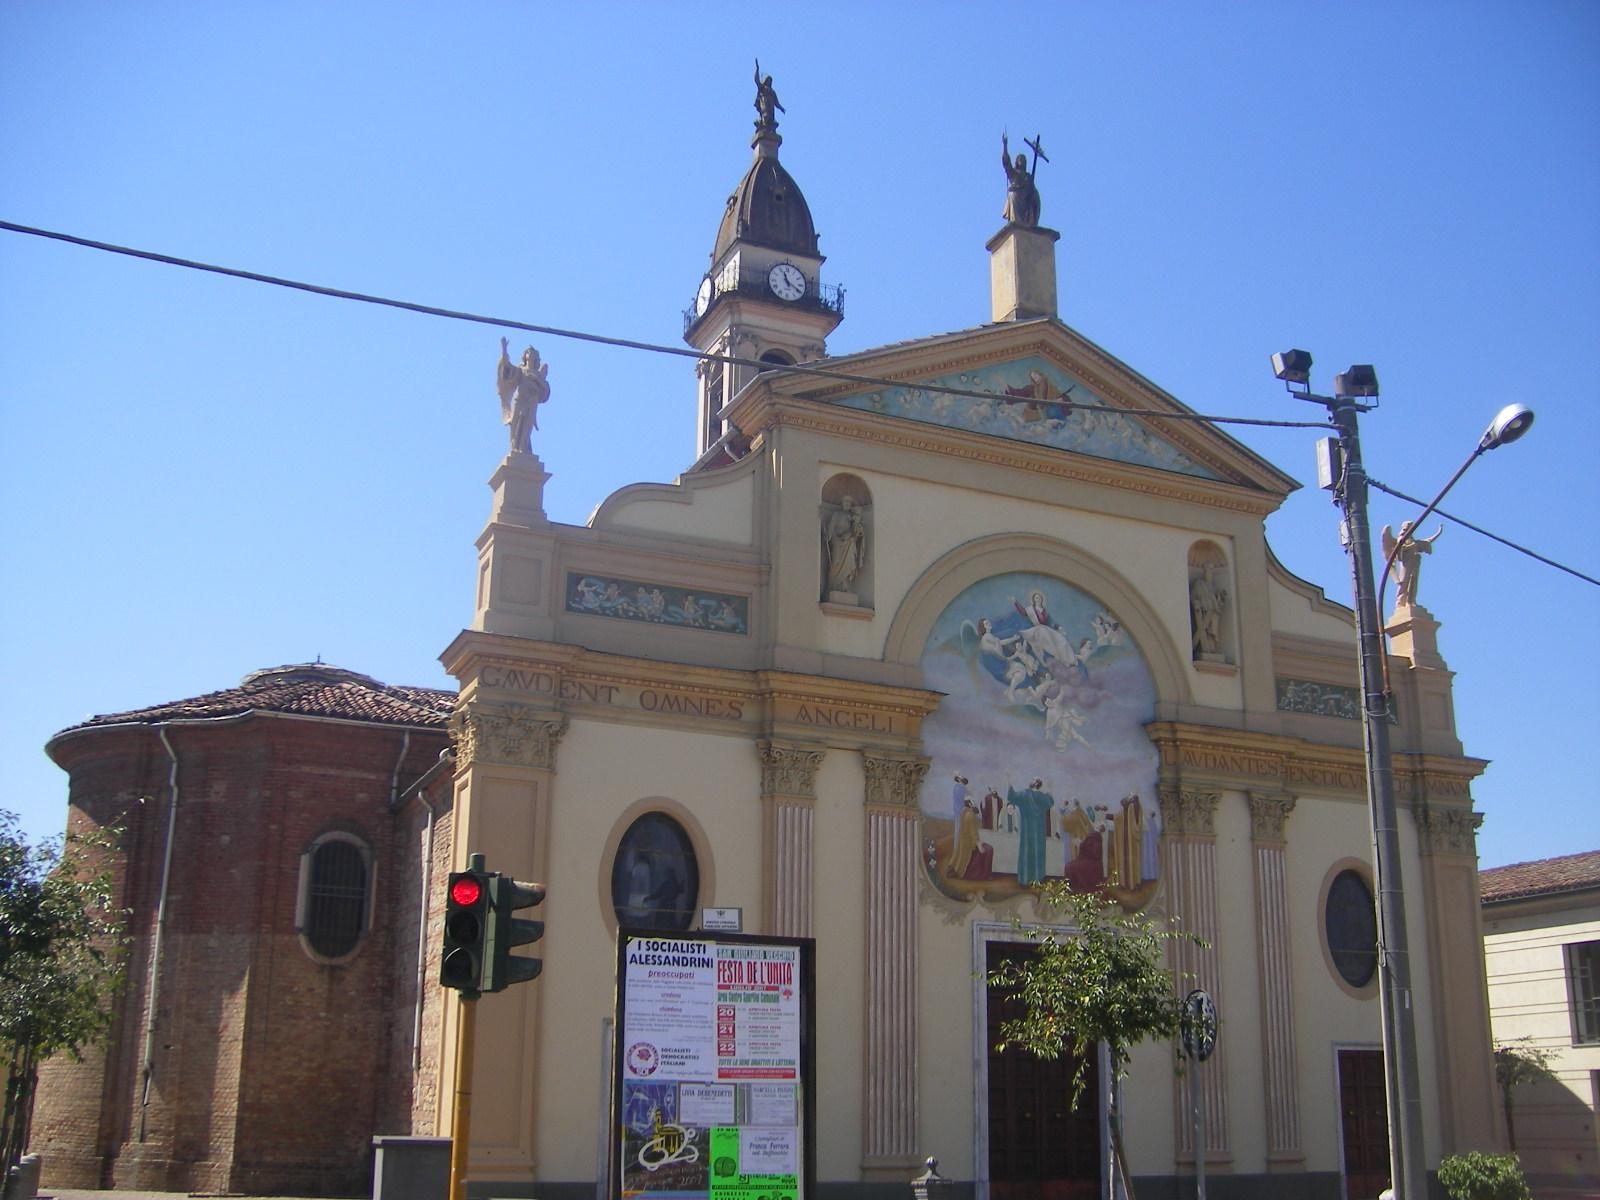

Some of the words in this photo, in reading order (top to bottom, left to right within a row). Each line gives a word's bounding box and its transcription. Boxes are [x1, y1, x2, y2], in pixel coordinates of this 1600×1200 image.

[480, 665, 620, 704] GAVDENT
[639, 689, 744, 720] OMNES
[796, 704, 893, 733] ANGELI
[637, 940, 642, 951] I
[645, 941, 706, 954] SOCIALISTI
[629, 953, 714, 969] ALESSANDRINI
[648, 970, 695, 980] preoccupati
[717, 960, 743, 984] FESTA
[747, 961, 757, 984] DE
[719, 1008, 734, 1017] 20
[719, 1025, 733, 1034] 21
[719, 1043, 735, 1052] 22
